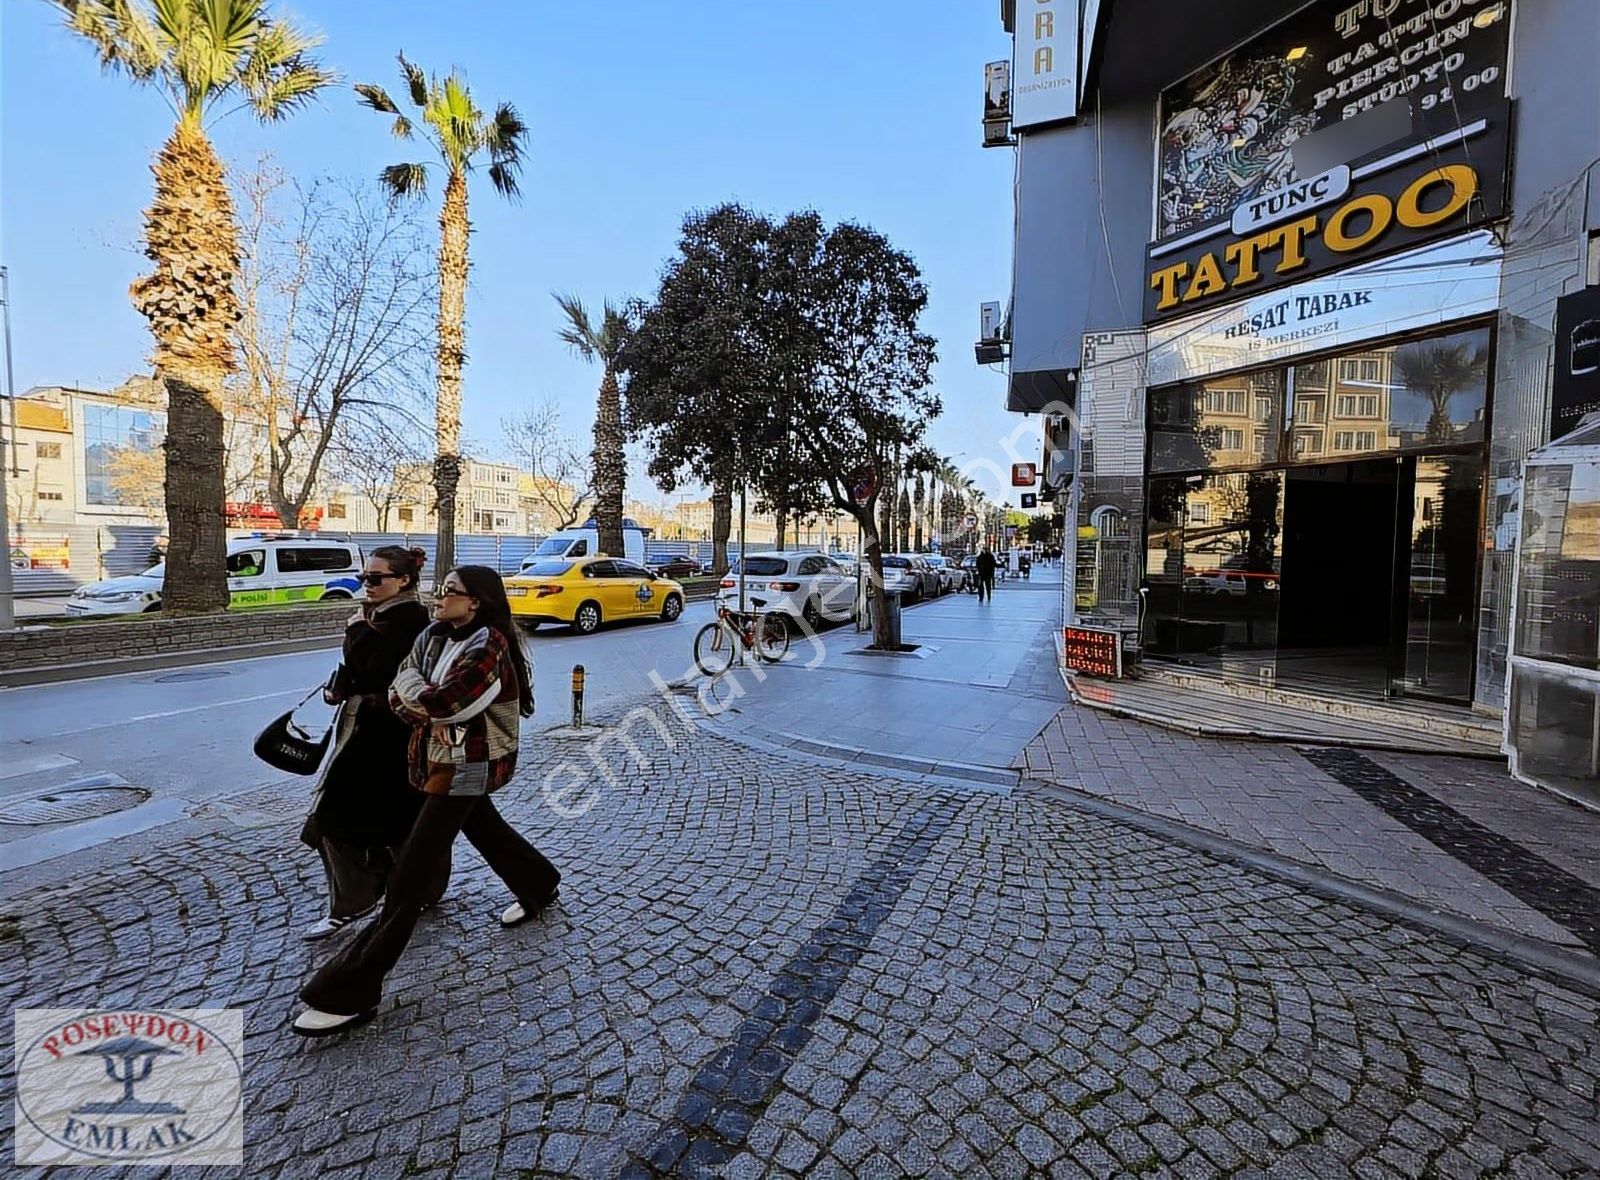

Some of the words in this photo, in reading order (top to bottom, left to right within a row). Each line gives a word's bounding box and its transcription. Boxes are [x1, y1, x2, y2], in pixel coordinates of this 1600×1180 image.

[1034, 0, 1053, 75] RA
[1327, 0, 1481, 75] TATTO
[1334, 0, 1416, 39] TU
[1313, 2, 1507, 110] PIERCING
[1342, 52, 1465, 120] STÜDYO
[1462, 66, 1499, 92] 00
[1250, 174, 1330, 222] TUNÇ
[1150, 164, 1478, 311] TATTOO
[1224, 300, 1290, 341] REŞAT
[1295, 289, 1373, 322] TABAK
[1266, 317, 1340, 347] MERKEZİ
